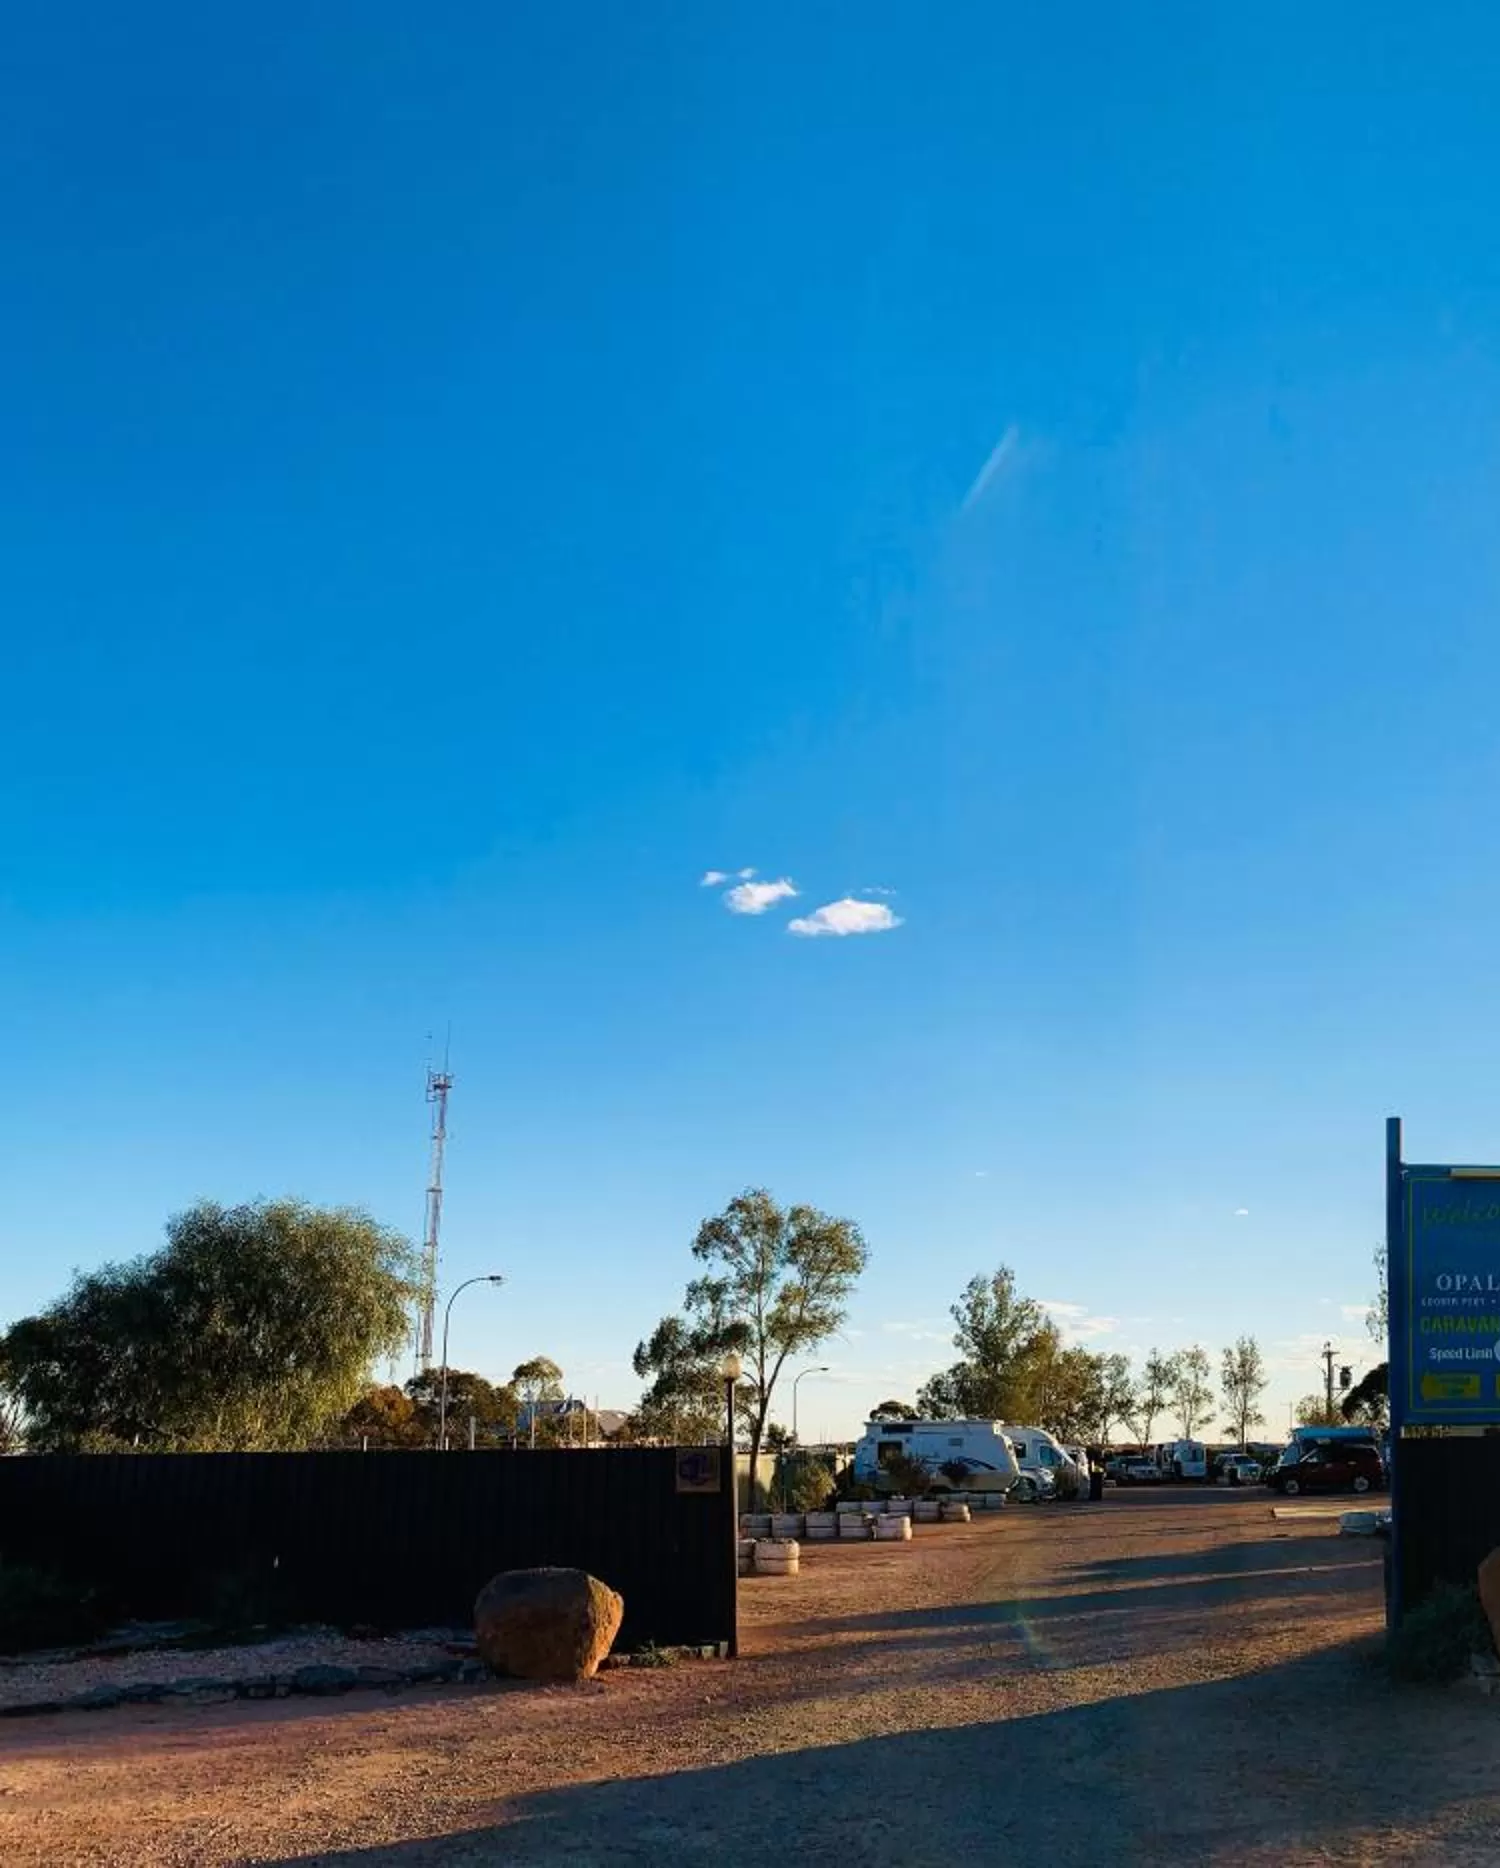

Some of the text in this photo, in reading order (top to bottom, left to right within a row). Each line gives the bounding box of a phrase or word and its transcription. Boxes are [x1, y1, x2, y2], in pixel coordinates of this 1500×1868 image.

[1435, 1272, 1500, 1292] OPAL
[1428, 1347, 1463, 1363] Speed
[1465, 1347, 1493, 1360] Limit
